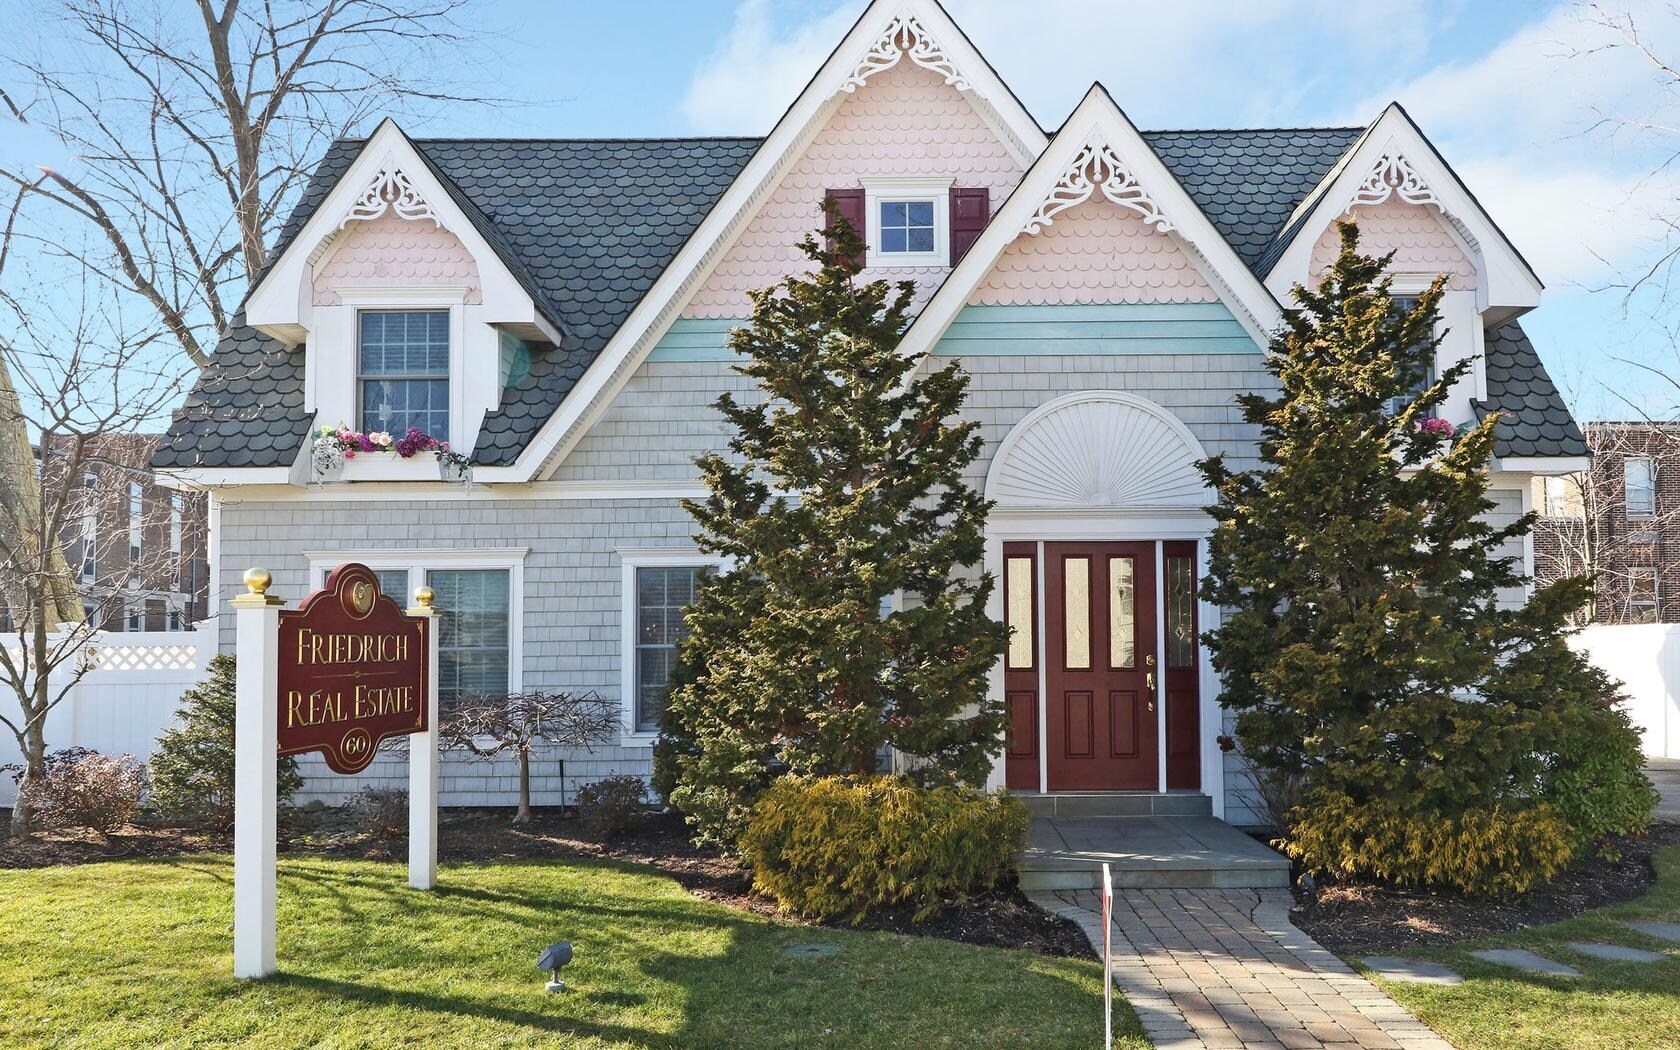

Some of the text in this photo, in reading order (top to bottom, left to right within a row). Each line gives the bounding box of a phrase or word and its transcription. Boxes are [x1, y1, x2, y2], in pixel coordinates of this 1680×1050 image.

[297, 628, 409, 665] FRIEDRICH
[354, 685, 413, 719] ESTATE
[345, 735, 366, 754] 60
